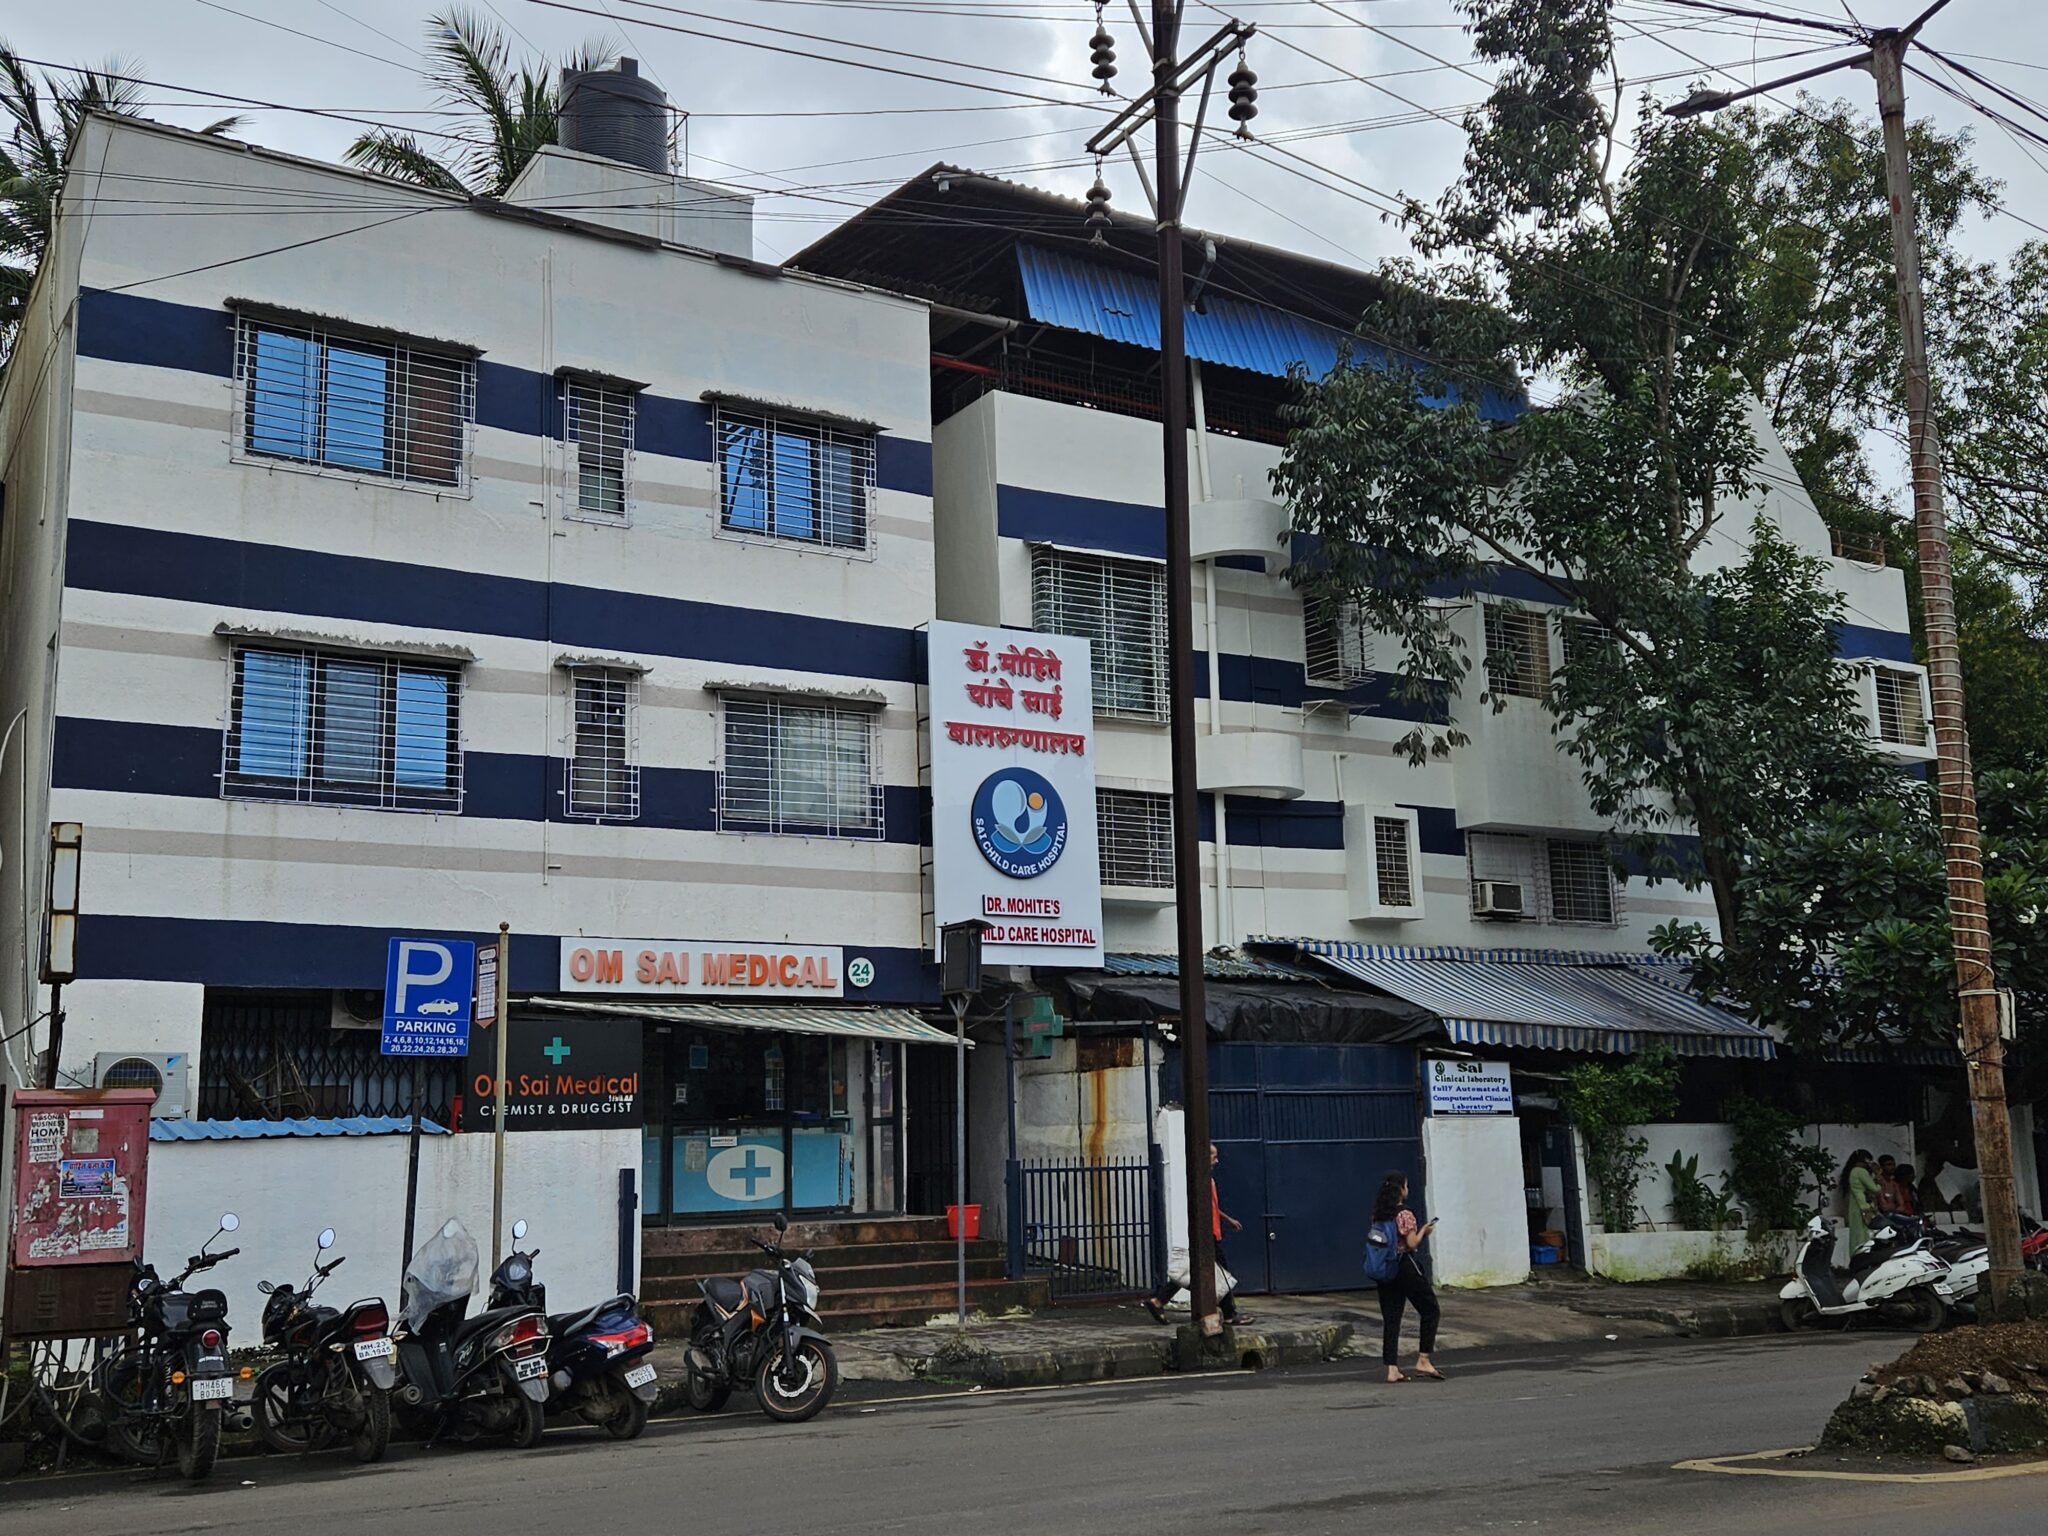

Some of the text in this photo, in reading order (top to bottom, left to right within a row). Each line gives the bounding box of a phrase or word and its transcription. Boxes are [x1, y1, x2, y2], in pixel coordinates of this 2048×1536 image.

[965, 677, 1063, 722] यांचे साई
[976, 817, 1066, 876] SAI CHILD CARE HOSPITAL
[987, 897, 1061, 915] DR. MOHITE'S
[1008, 926, 1038, 942] CARE
[1041, 927, 1096, 944] HOSPITAL
[569, 947, 837, 988] OM SAI MEDICAL
[852, 963, 870, 977] 24
[395, 941, 453, 1014] P
[395, 1020, 457, 1033] PARKING
[519, 1074, 549, 1097] Sai
[556, 1072, 638, 1095] Medical
[1435, 1074, 1506, 1085] Clinical laboratory
[547, 1104, 556, 1115] &
[561, 1102, 632, 1115] DRUGGIST
[1452, 1103, 1493, 1111] Laboratory
[31, 1126, 66, 1138] HOME
